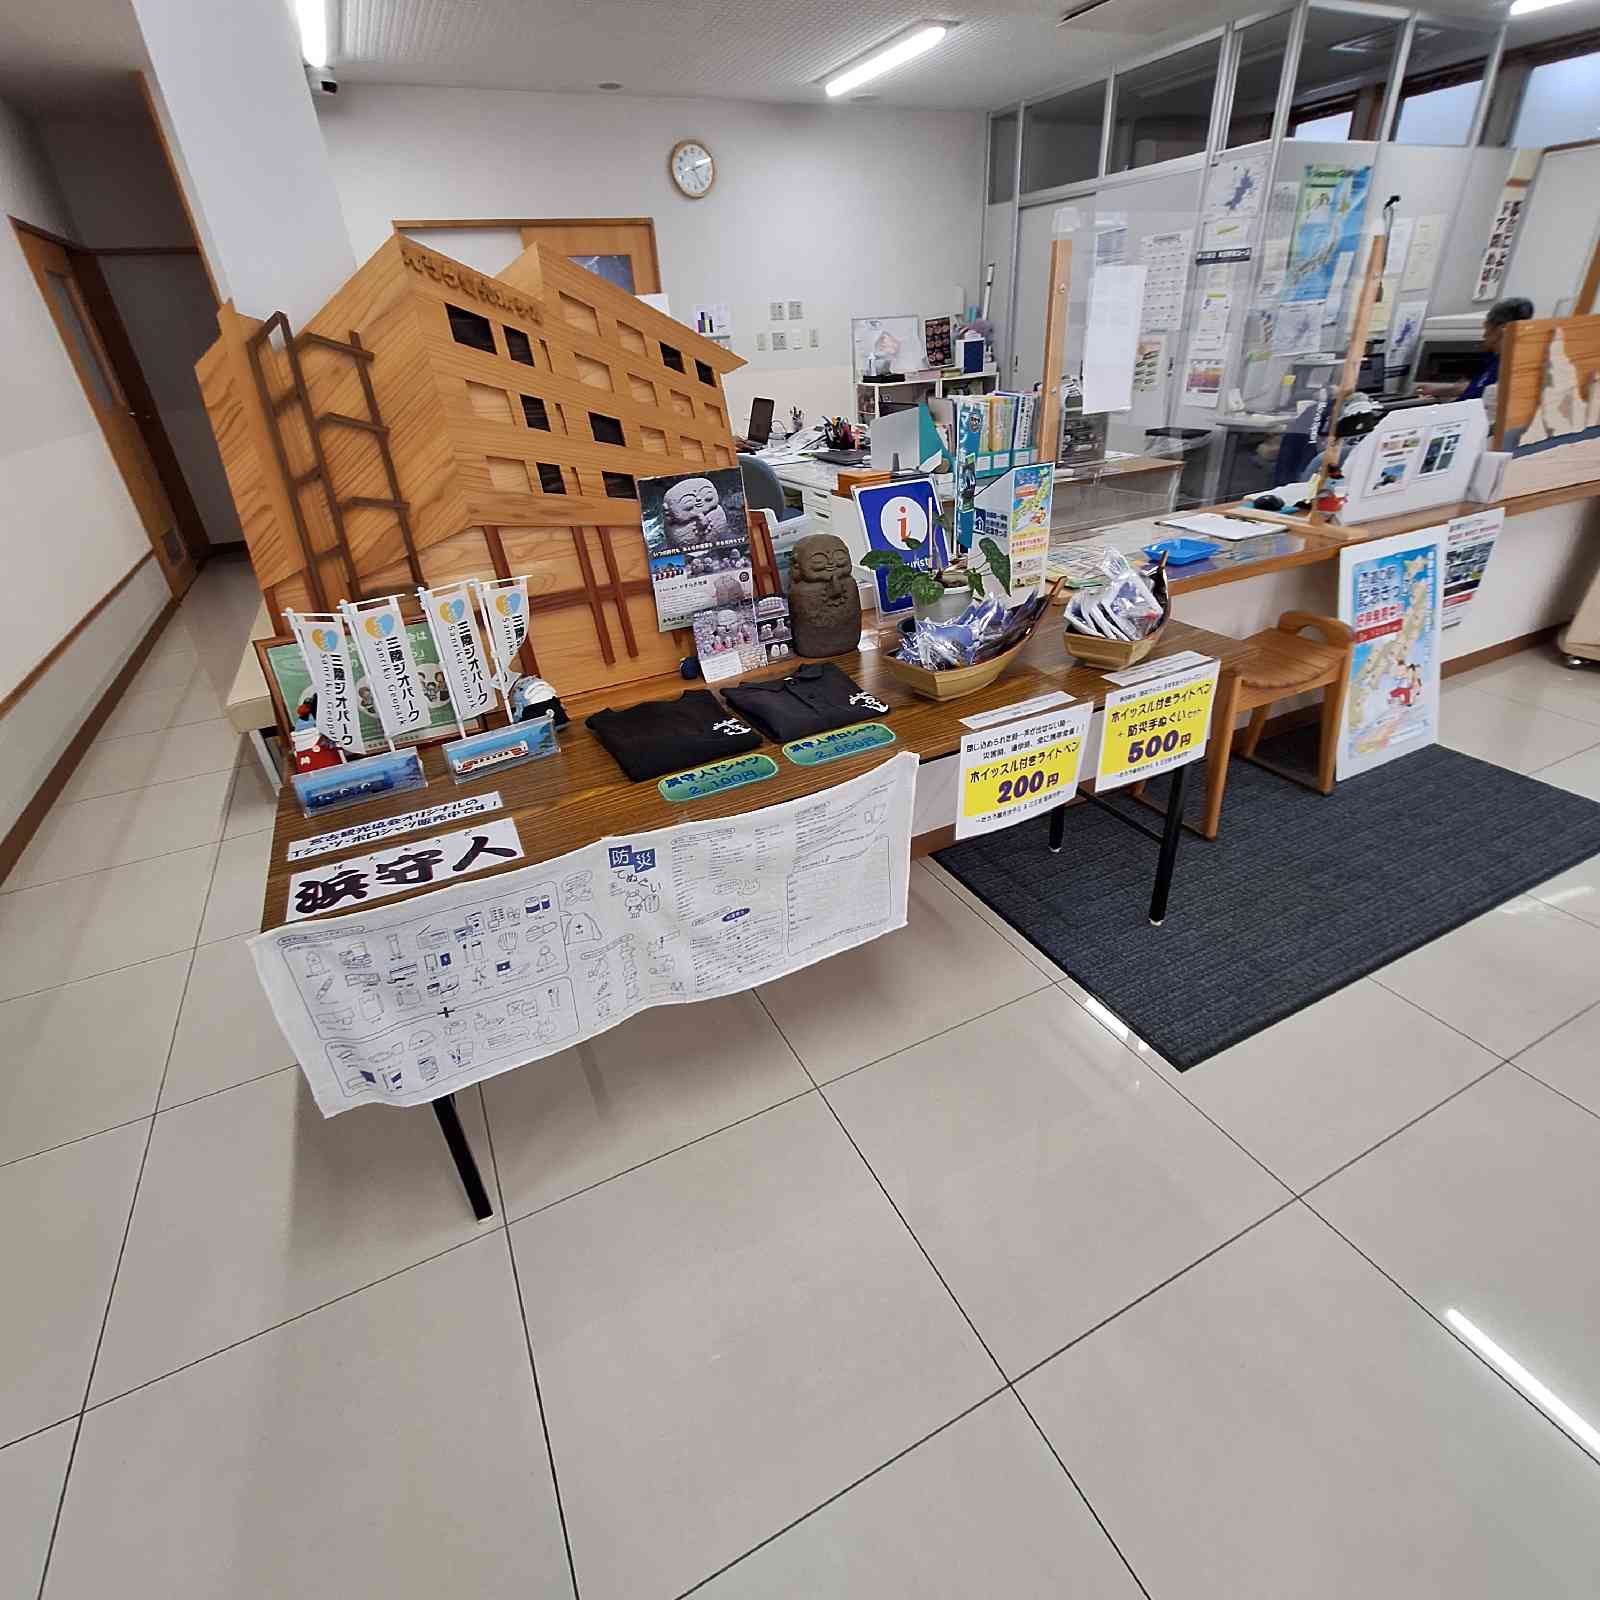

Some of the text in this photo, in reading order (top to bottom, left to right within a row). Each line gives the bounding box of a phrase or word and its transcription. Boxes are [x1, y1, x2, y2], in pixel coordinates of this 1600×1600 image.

[386, 636, 420, 723] 三陸ジオパーク
[457, 620, 488, 706] 三陸ジオパーク
[330, 654, 353, 746] 三陸ジオパーク
[1111, 683, 1213, 723] ホイッスル付きライトペン
[970, 740, 1081, 784] ホイッスル付きライトペン
[1127, 729, 1191, 764] 500円
[996, 771, 1060, 804] 200円
[309, 797, 478, 847] 宮古観光協会オリジナルの
[612, 869, 662, 893] てぬぐい
